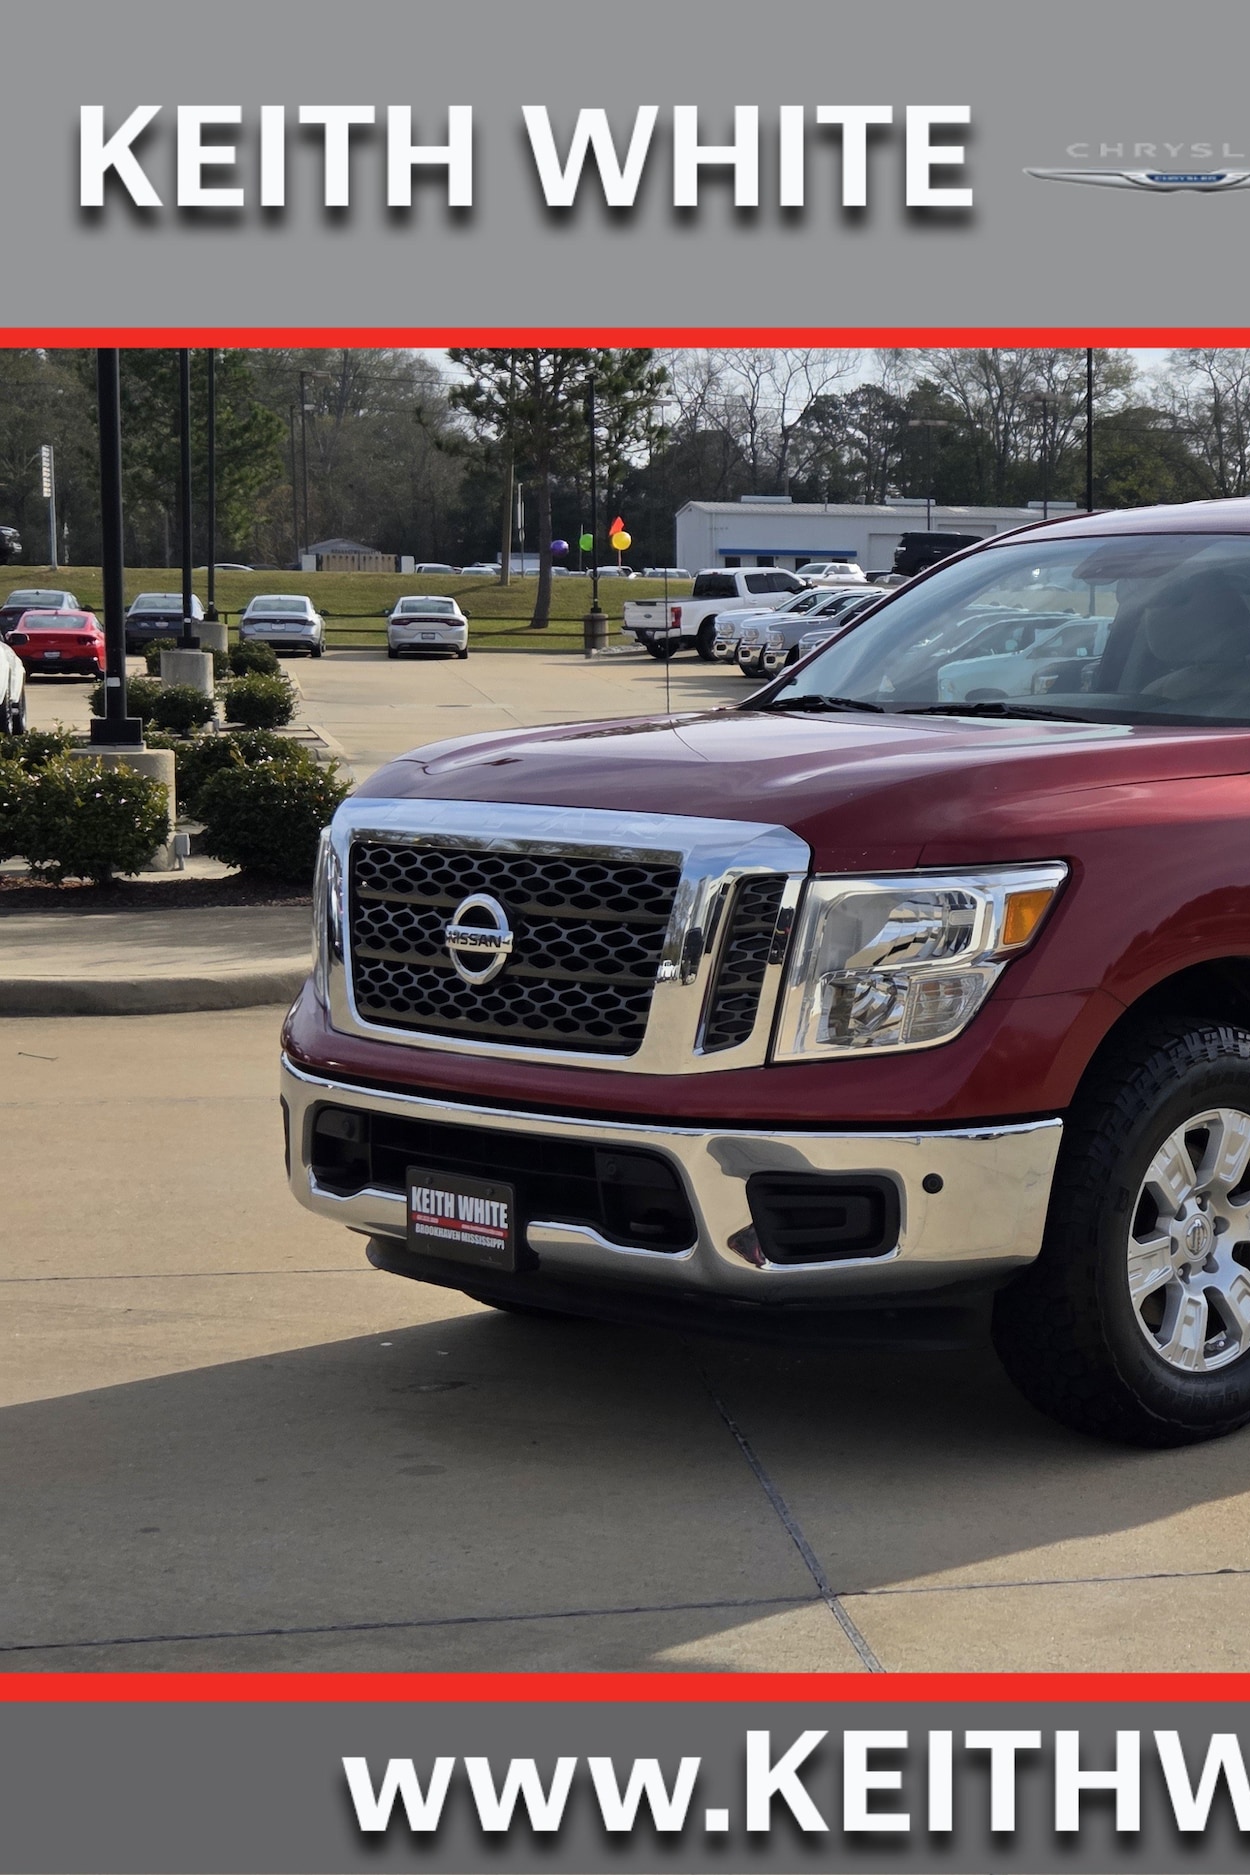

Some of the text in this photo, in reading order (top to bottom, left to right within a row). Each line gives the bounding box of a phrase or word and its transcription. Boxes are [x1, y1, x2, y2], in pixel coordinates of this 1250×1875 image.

[448, 931, 502, 948] NISSAN
[411, 1185, 508, 1229] KEITH WHITE
[415, 1223, 461, 1241] BROOKHAVEN
[461, 1232, 505, 1250] MISSISSIPPI
